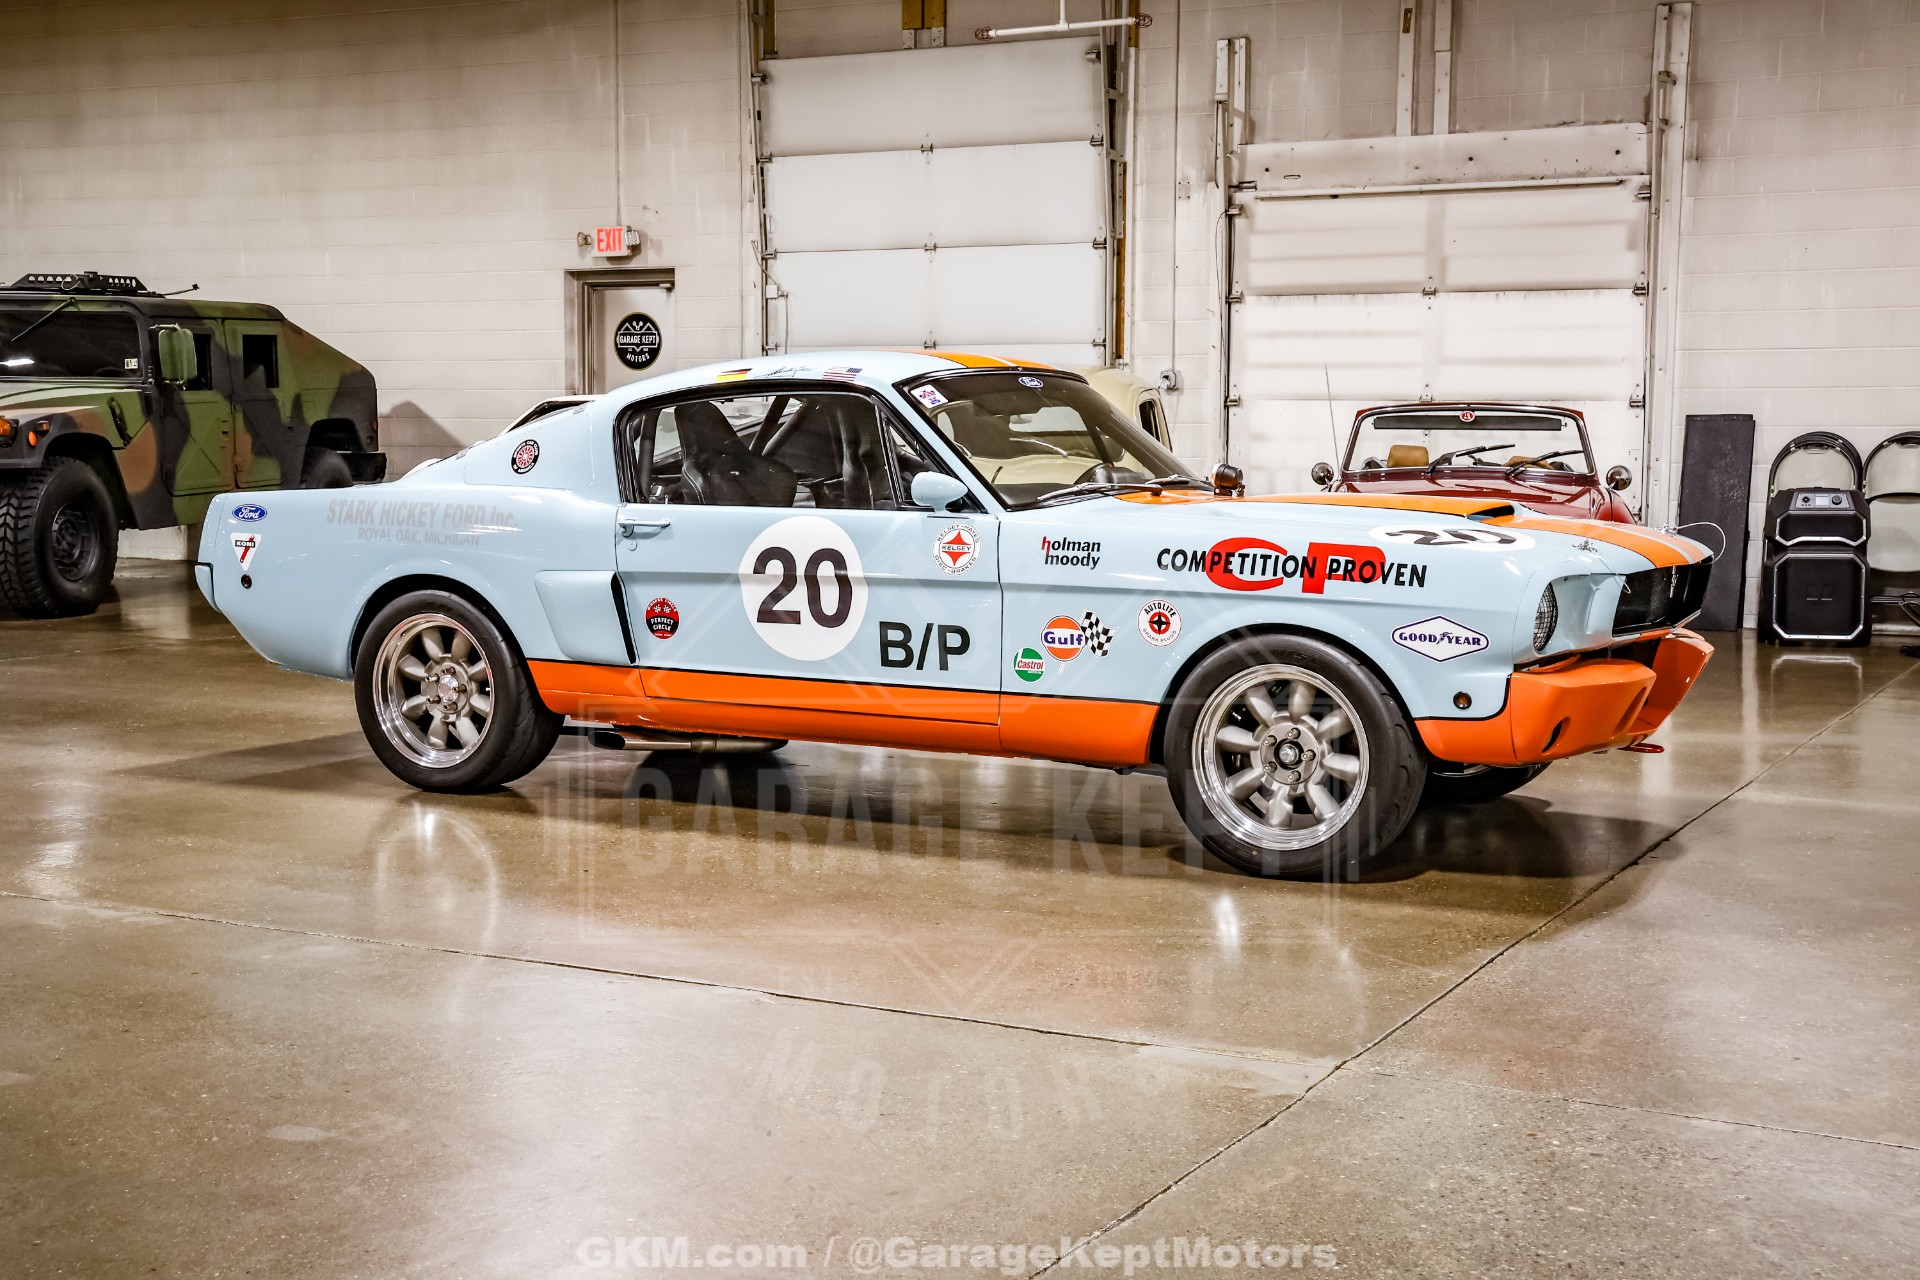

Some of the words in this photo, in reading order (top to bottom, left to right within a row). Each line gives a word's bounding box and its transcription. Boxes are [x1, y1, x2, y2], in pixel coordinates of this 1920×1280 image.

[596, 227, 623, 253] EXIT
[619, 335, 641, 344] GARAGE
[641, 335, 656, 344] KEPT
[626, 352, 650, 363] MOTORS
[238, 506, 261, 519] Ford
[326, 498, 377, 525] STARK
[379, 500, 440, 528] HICKEY
[441, 502, 486, 529] FORD
[489, 505, 518, 528] Inc.
[235, 540, 255, 548] KONI
[358, 527, 392, 543] ROYAL
[395, 529, 422, 545] OAK,
[424, 531, 480, 547] MICHIGAN
[1041, 536, 1101, 553] holman
[1385, 528, 1517, 546] 20
[1045, 552, 1101, 570] moody
[1156, 548, 1318, 579] COMPETITION
[1327, 557, 1427, 588] PROVEN
[752, 546, 853, 628] 20
[1143, 602, 1177, 618] AUTOLITE
[650, 617, 674, 626] PERFECT
[653, 624, 672, 632] CIRCLE
[1043, 630, 1085, 646] Gulf
[1142, 628, 1159, 642] SPARK
[1160, 629, 1177, 643] PLUGS
[878, 620, 971, 671] B/P
[1017, 659, 1044, 670] Castrol
